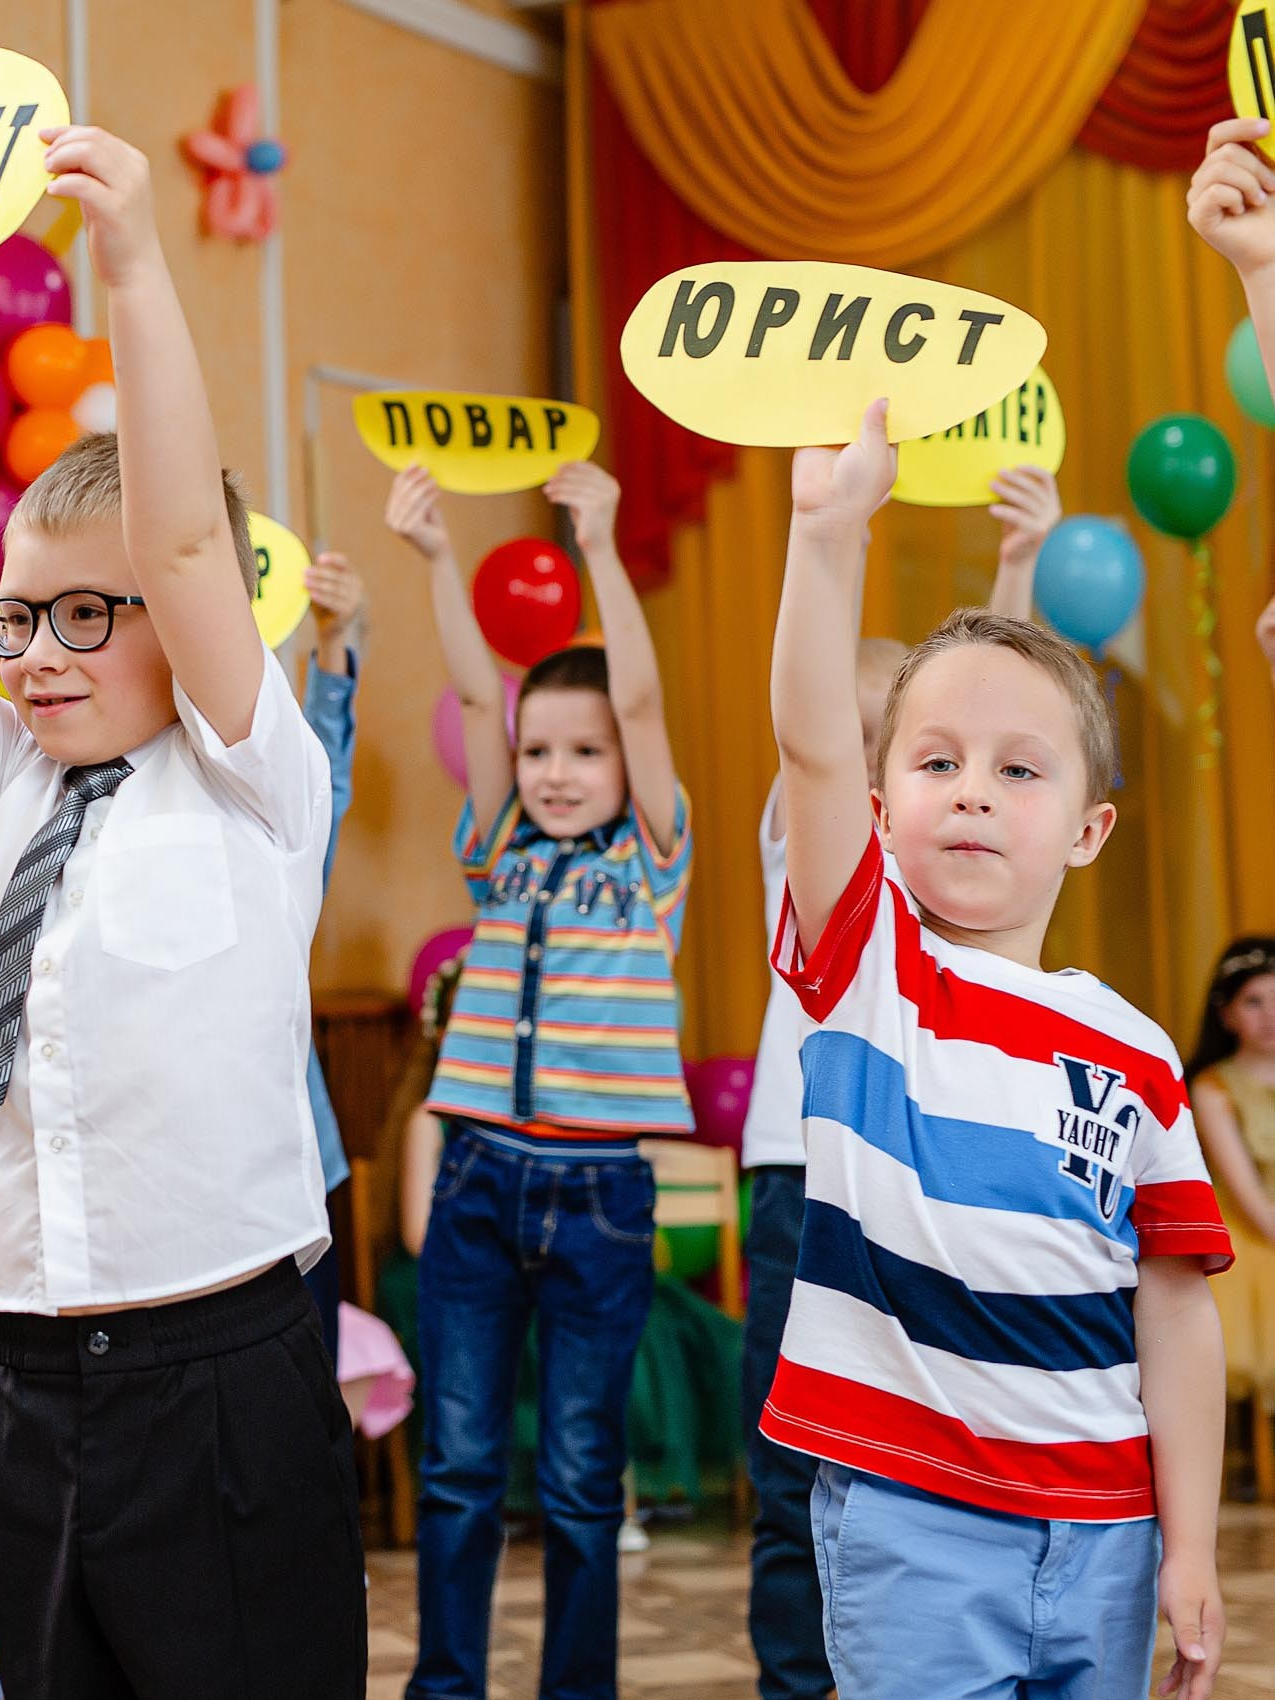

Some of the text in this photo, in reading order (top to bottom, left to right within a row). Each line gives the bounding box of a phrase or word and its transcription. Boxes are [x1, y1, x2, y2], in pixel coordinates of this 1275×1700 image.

[658, 280, 1005, 366] ЮРИСТ
[382, 401, 567, 450] ПОВАР
[1057, 1109, 1120, 1163] YACHT
